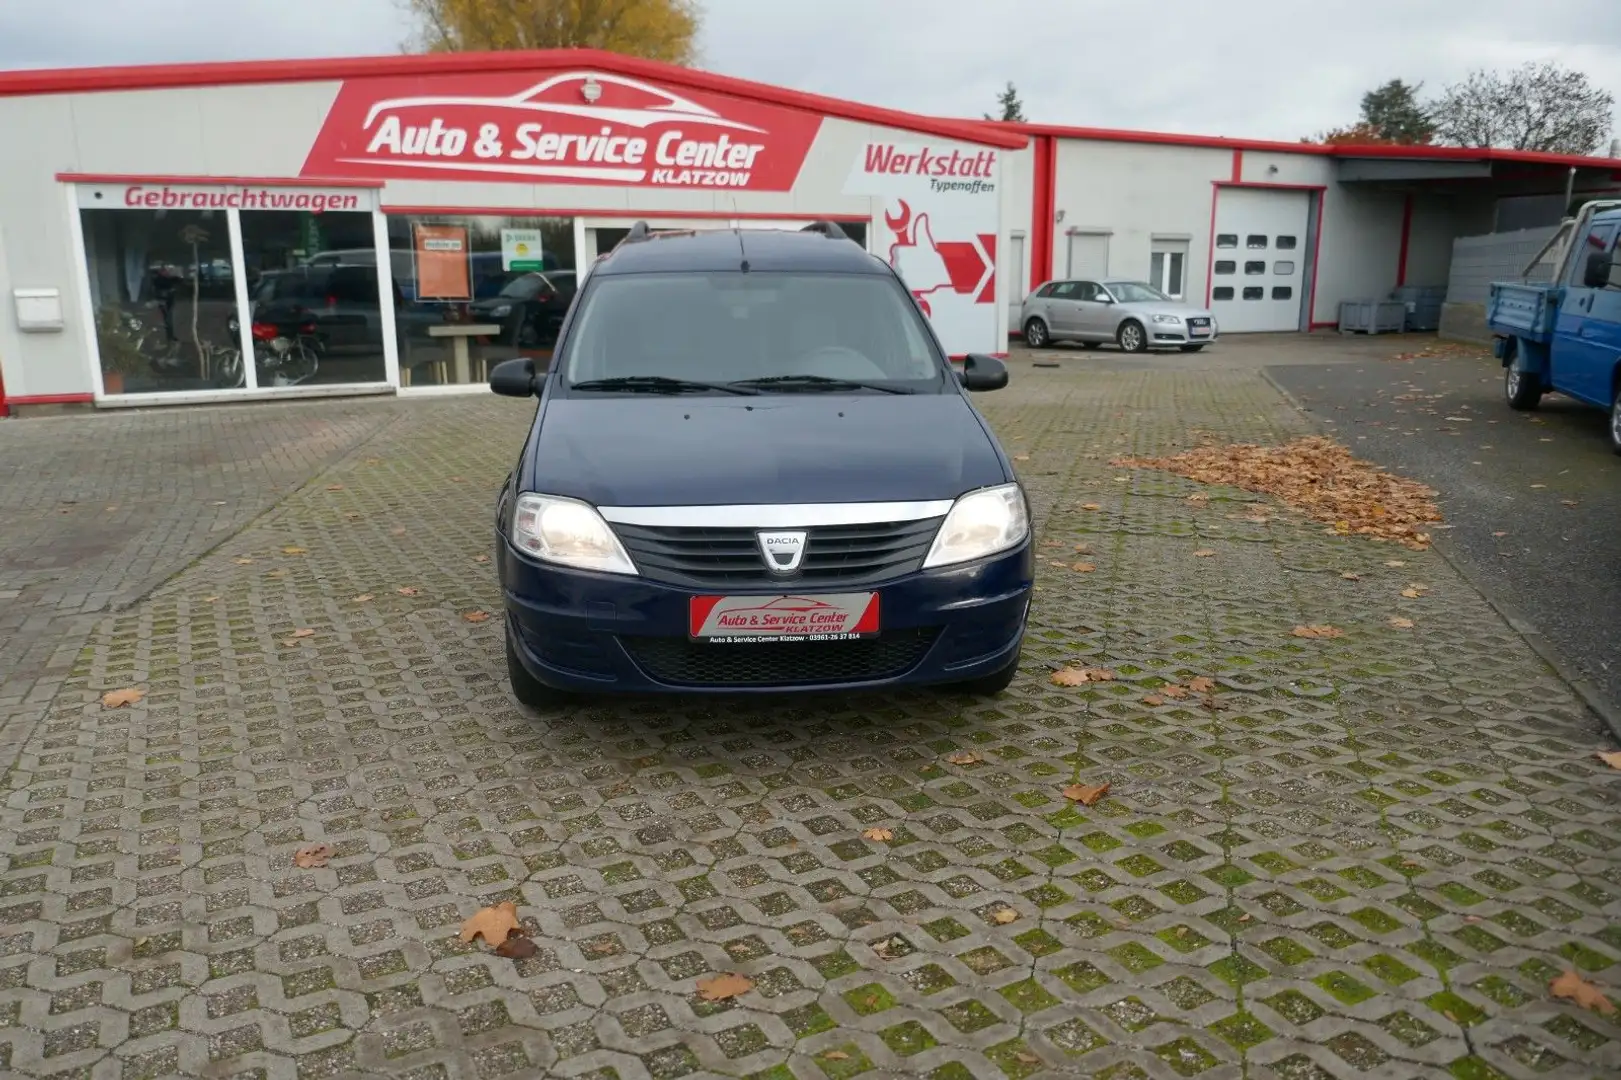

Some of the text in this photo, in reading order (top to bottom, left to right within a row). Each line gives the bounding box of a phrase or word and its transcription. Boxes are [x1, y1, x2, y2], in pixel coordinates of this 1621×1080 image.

[367, 116, 765, 169] Auto & Service Center
[864, 143, 997, 178] Werkstatt
[650, 168, 752, 187] KLATZOW
[929, 178, 996, 194] Typenoffen
[124, 185, 358, 214] Gebrauchtwagen
[766, 537, 800, 545] DACIA
[718, 611, 849, 627] Auto & Service Center
[785, 624, 844, 633] KLATZOW
